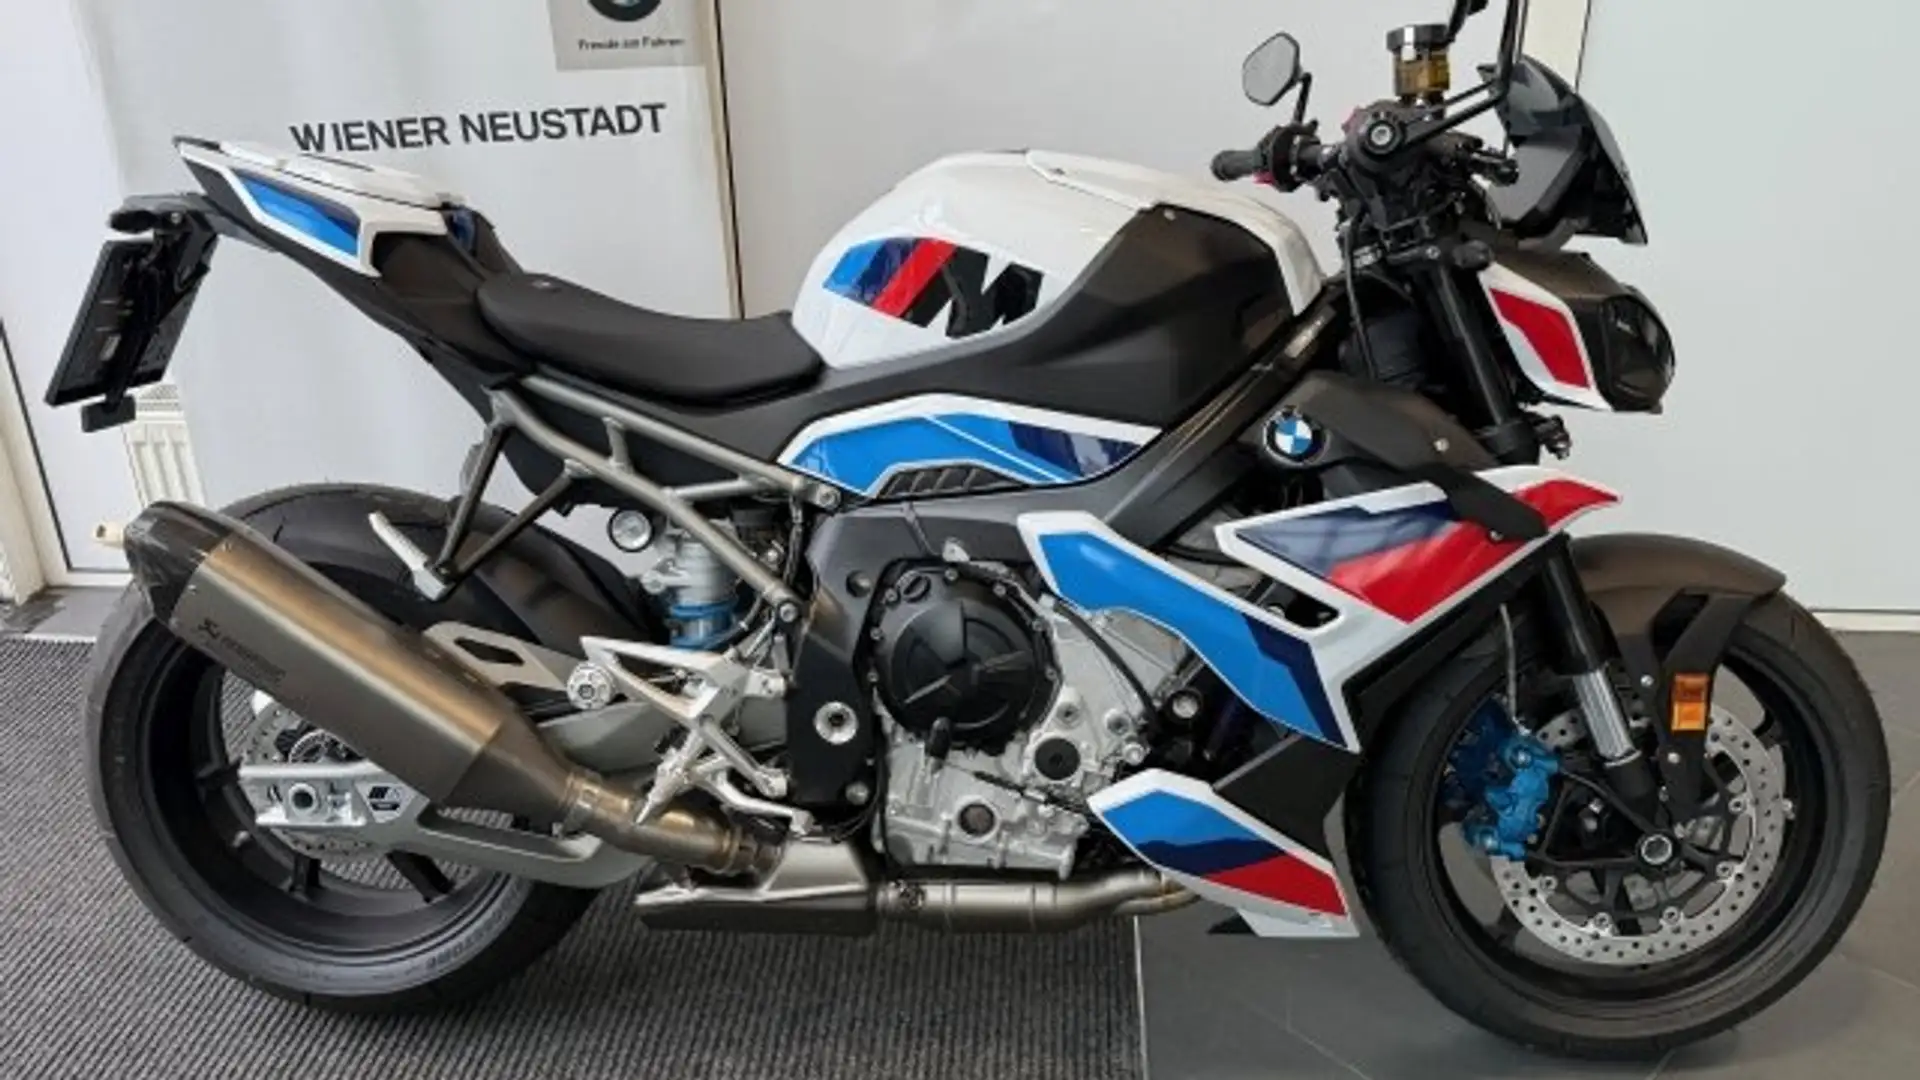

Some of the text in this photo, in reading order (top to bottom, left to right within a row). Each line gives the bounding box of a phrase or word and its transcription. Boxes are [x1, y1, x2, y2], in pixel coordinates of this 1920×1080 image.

[289, 102, 667, 152] WIENER NEUSTADT
[901, 245, 1045, 339] M
